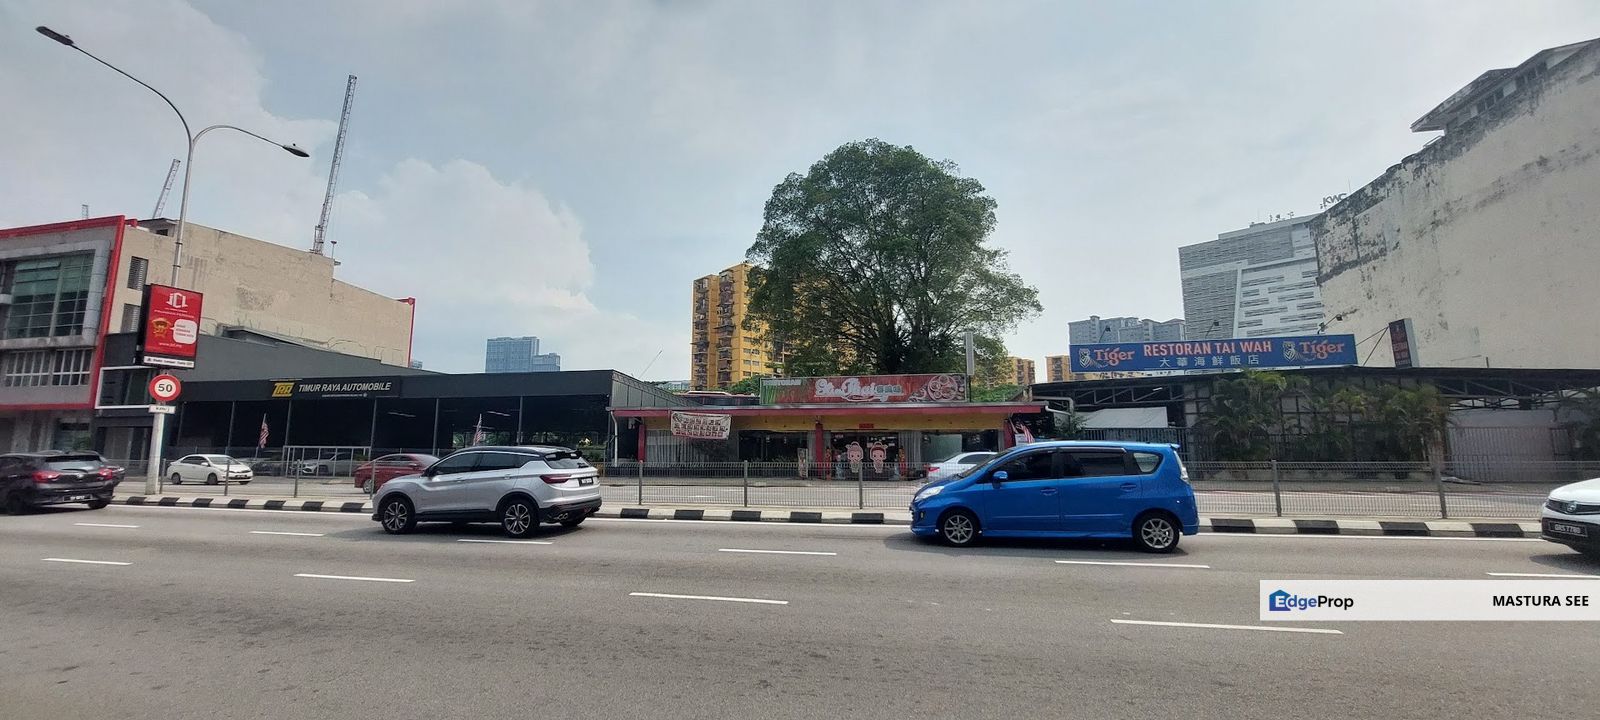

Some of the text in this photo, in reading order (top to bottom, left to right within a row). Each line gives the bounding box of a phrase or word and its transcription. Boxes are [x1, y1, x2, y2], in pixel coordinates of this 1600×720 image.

[1143, 341, 1272, 356] RESTORAN TAI WAH
[1299, 340, 1344, 359] Tiger
[1094, 347, 1135, 366] Tiger
[1159, 354, 1259, 367] 大華海鮮飯店
[158, 384, 172, 392] 50
[299, 382, 392, 392] TIMUR RAYA AUTOMOBILE
